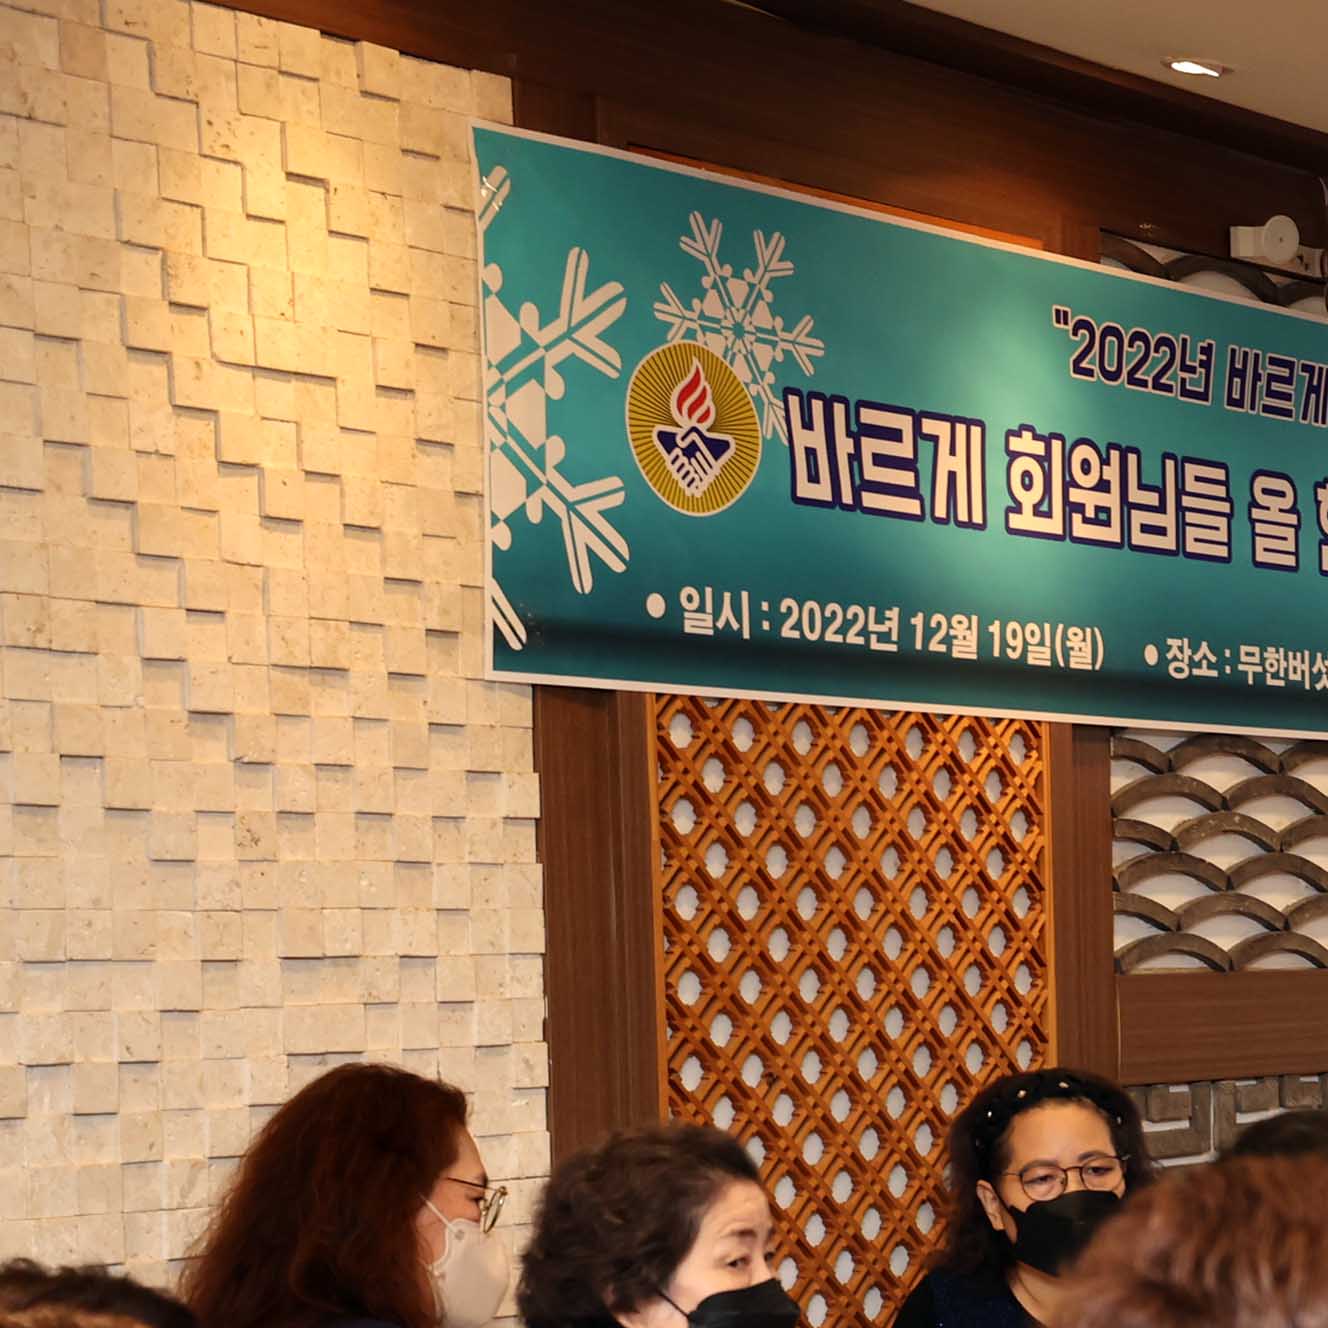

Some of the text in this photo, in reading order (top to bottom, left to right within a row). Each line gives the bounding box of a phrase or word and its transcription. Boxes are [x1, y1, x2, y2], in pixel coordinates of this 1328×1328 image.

[783, 388, 987, 530] 바르게
[1003, 424, 1234, 563] 회원님들
[1249, 469, 1300, 570] 올
[679, 586, 750, 639] 일시
[780, 597, 900, 652] 2022년
[910, 612, 978, 660] 12월
[988, 620, 1104, 670] 19일(월)
[1166, 637, 1219, 680] 장소
